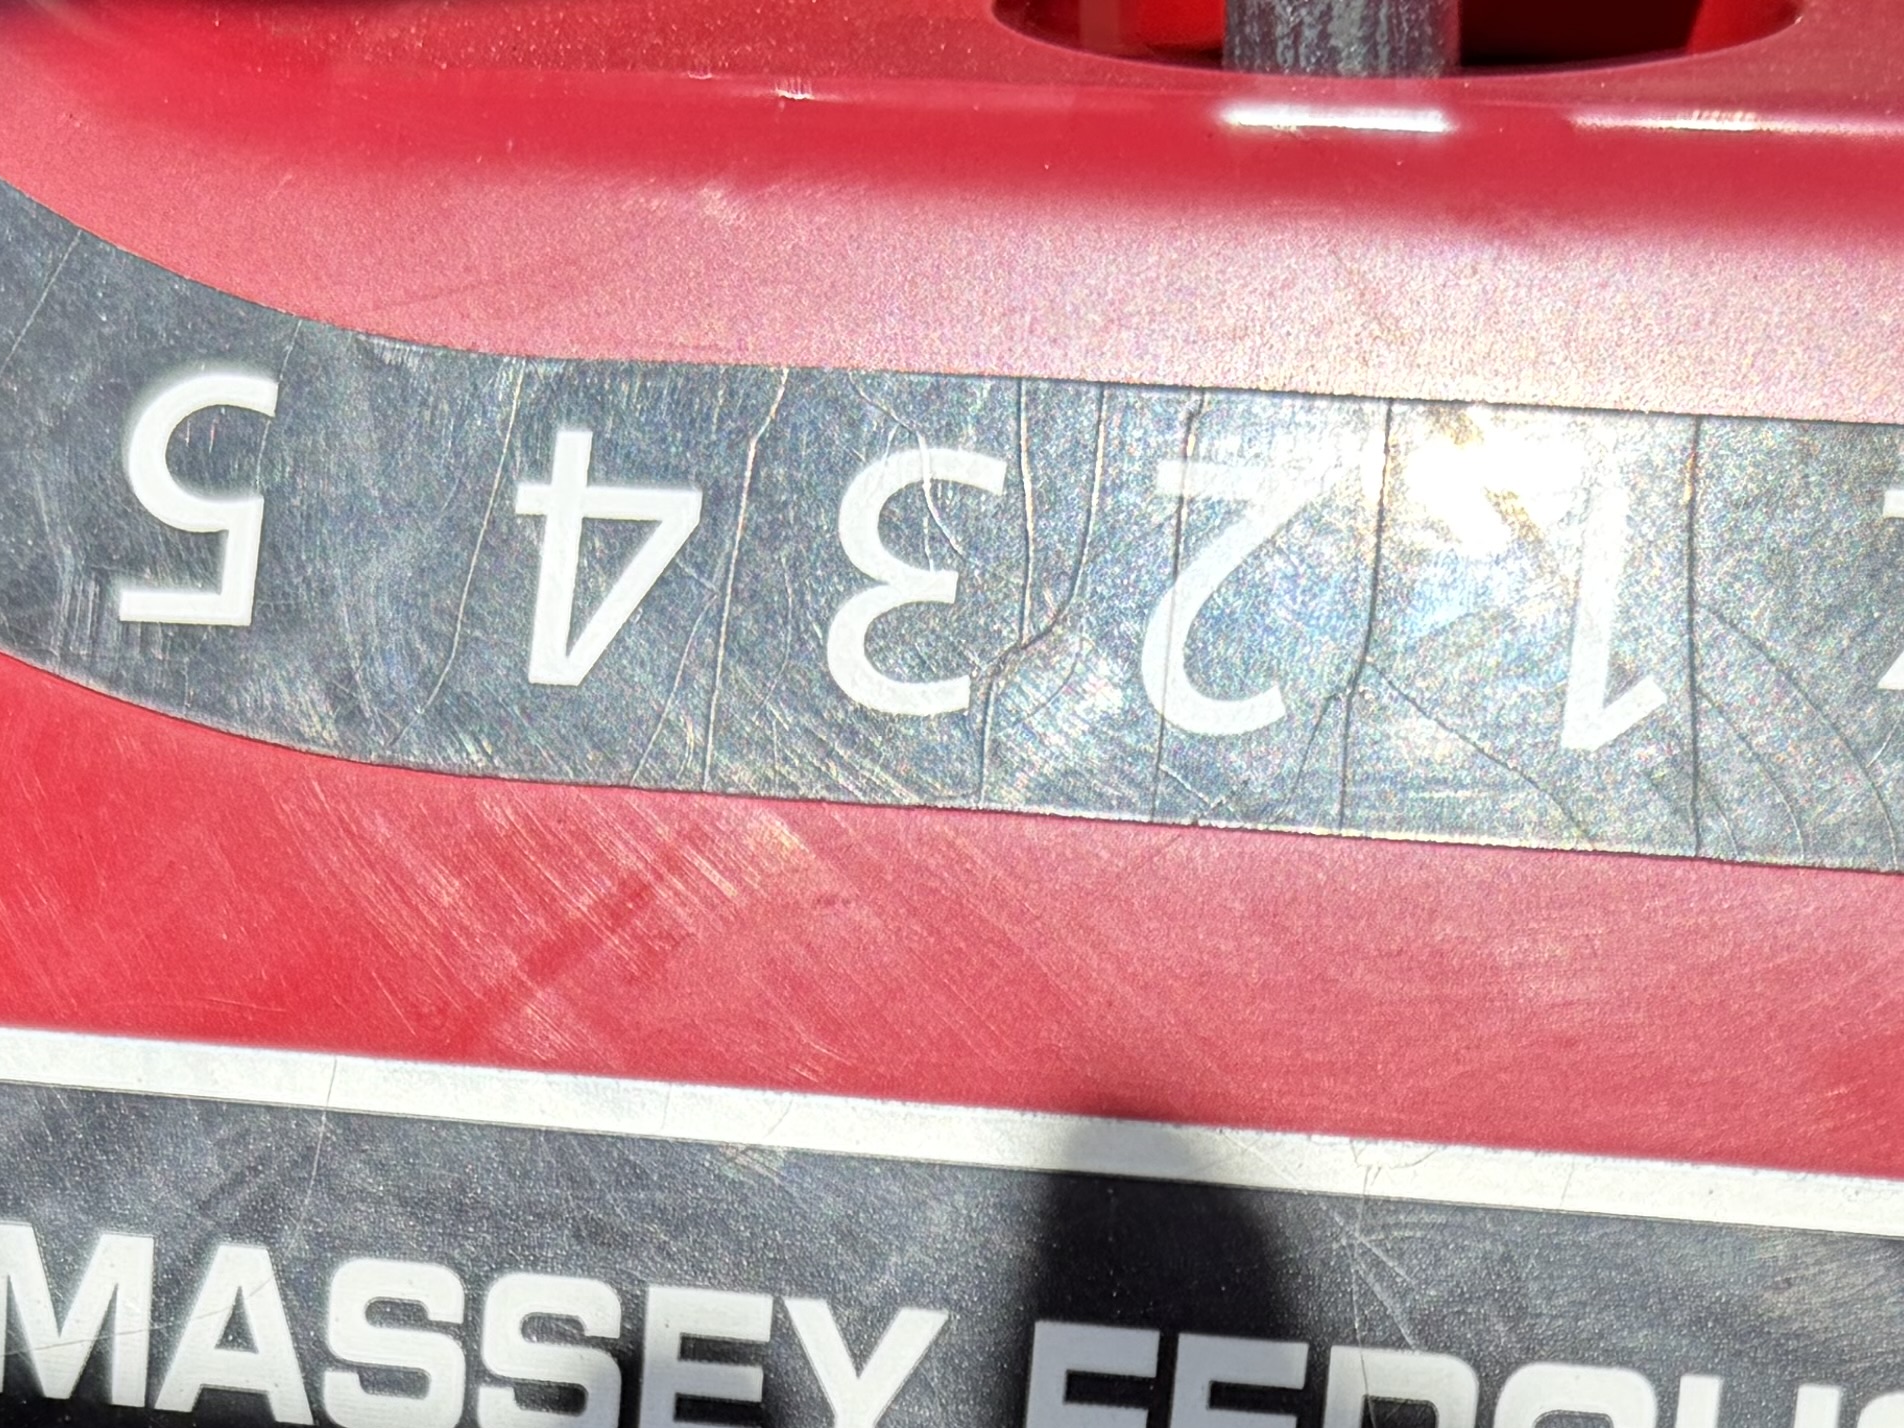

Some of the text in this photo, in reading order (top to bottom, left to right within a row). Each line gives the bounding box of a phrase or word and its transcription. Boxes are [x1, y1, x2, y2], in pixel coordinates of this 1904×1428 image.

[118, 372, 279, 627] 5
[514, 428, 702, 686] 4
[826, 447, 1006, 716] 3
[1141, 459, 1314, 736] 2
